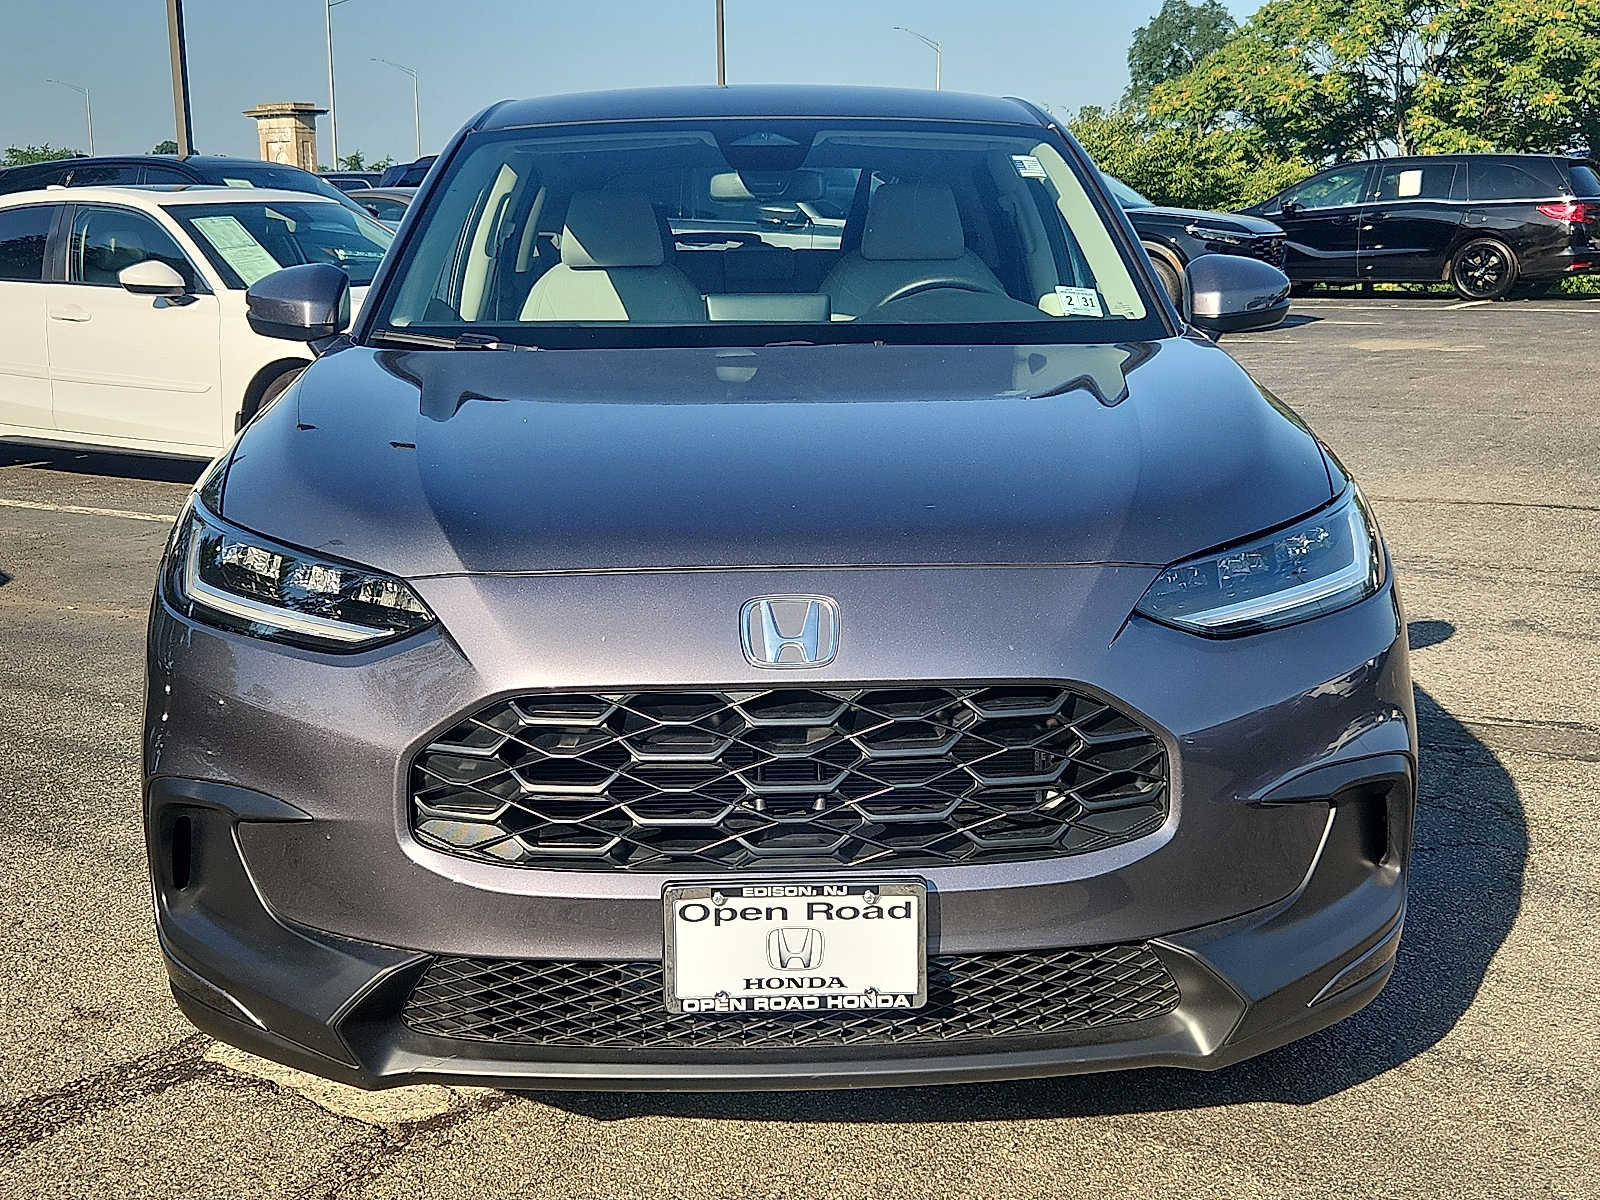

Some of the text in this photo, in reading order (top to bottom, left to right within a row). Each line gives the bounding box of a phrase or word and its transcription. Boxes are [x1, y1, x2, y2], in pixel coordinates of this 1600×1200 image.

[1066, 295, 1096, 308] 2 31
[742, 885, 848, 897] EDISON, NJ
[678, 901, 912, 927] Open Road
[743, 976, 848, 990] HONDA
[682, 994, 911, 1012] OPEN ROAD HONDA
